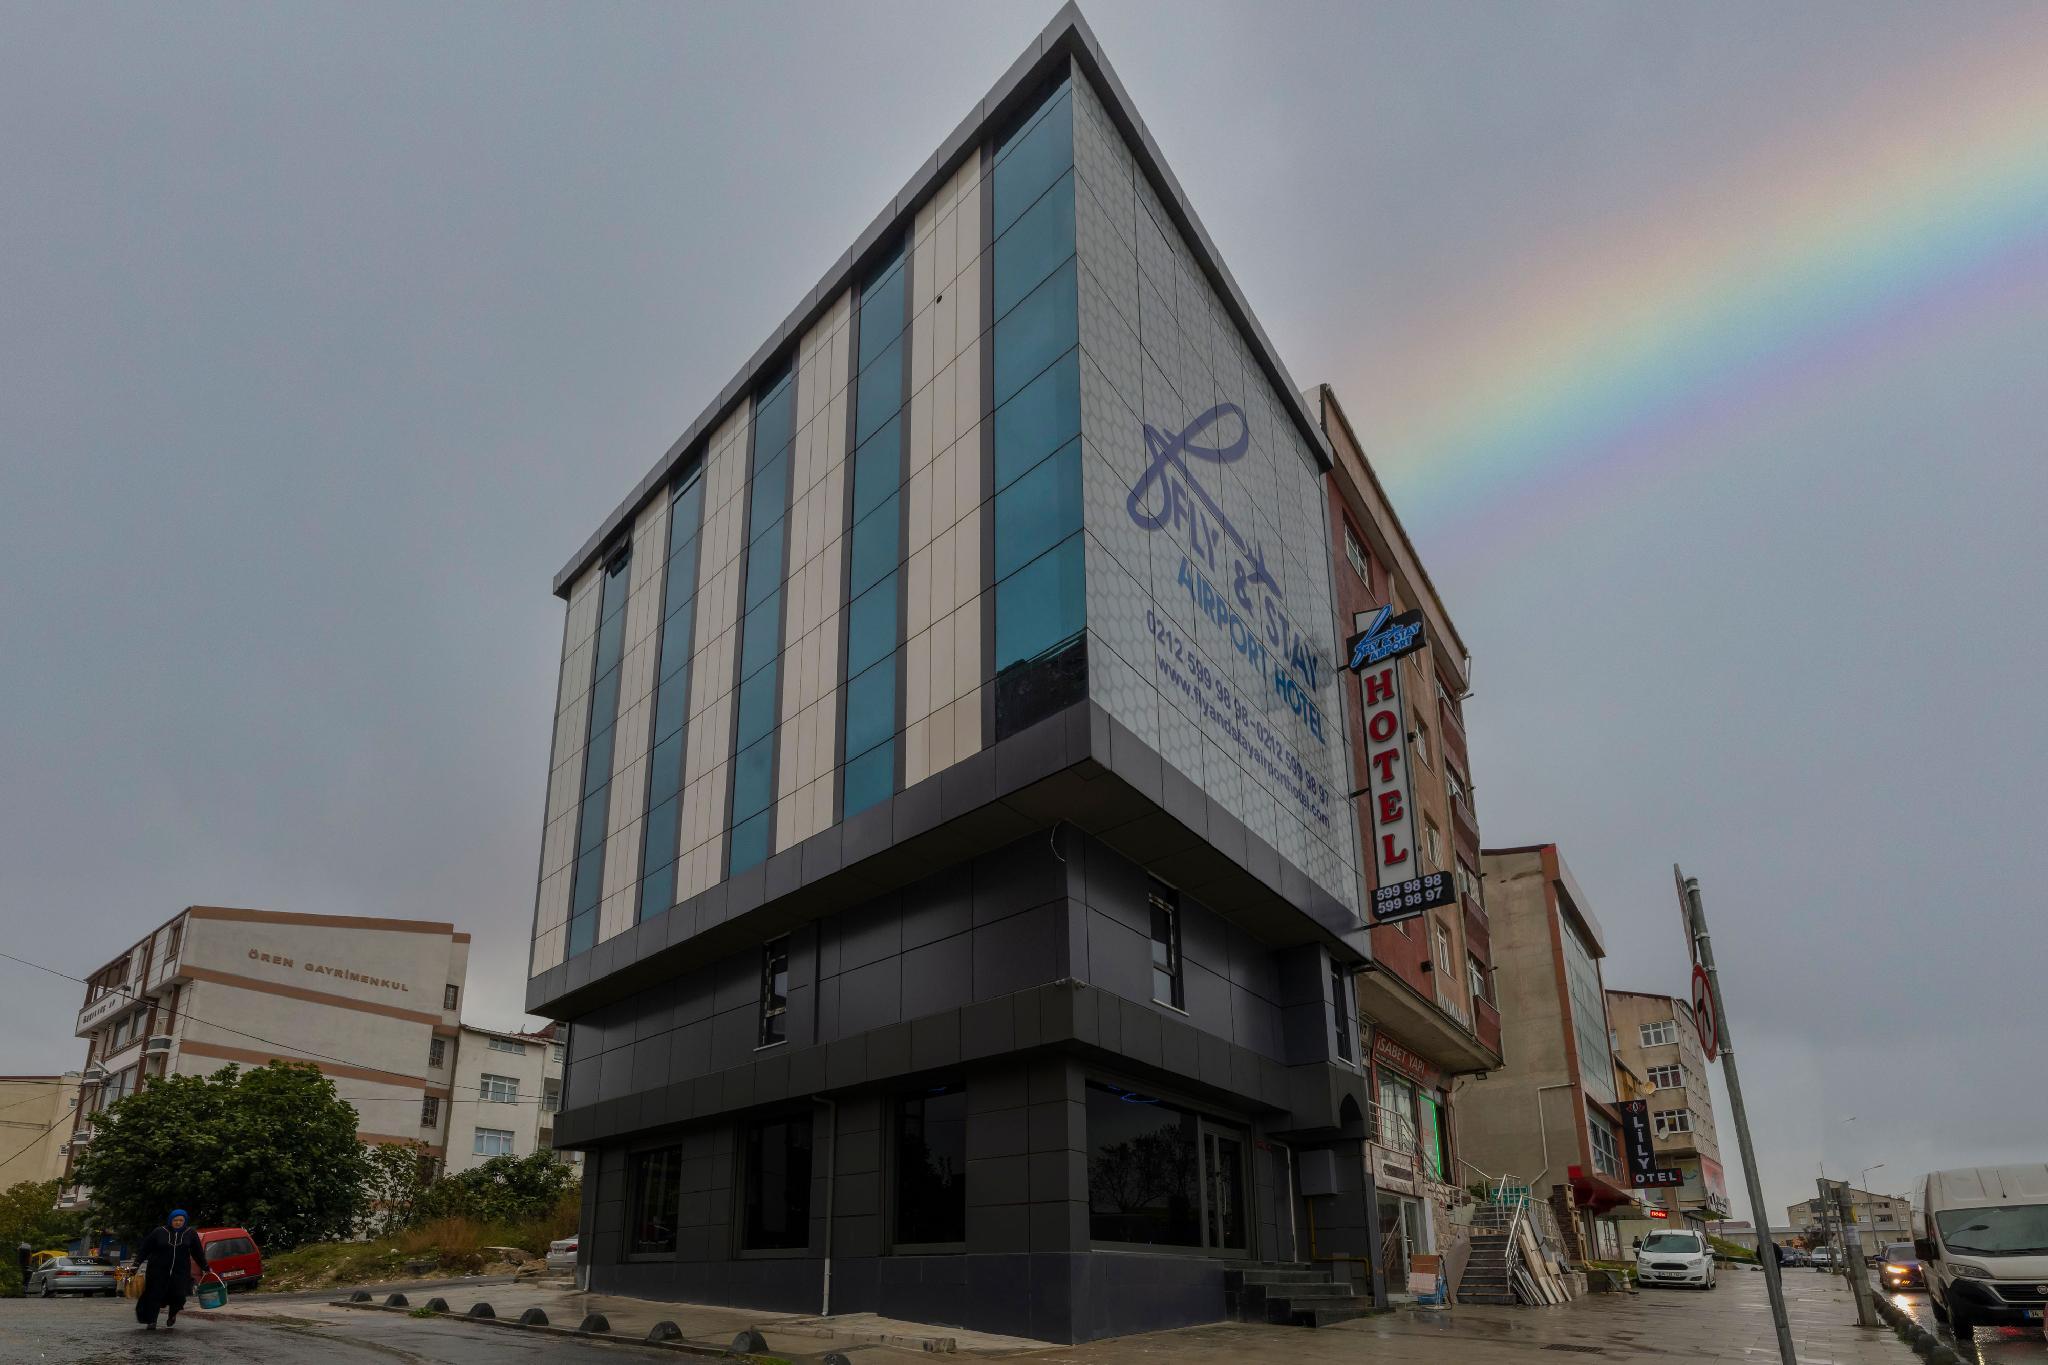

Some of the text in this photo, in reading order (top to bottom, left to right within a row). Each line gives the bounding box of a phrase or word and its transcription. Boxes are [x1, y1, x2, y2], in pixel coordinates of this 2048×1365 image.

[1171, 475, 1318, 693] FLY & STAY
[1370, 636, 1414, 662] AIRPORT
[1394, 621, 1421, 641] STAY
[1177, 555, 1326, 745] AIRPORT HOTEL
[1146, 609, 1183, 663] 0212
[1187, 650, 1212, 690] 599
[1215, 679, 1231, 710] 98
[1285, 750, 1303, 783] 599
[1305, 769, 1317, 796] 98
[1318, 783, 1329, 808] 97
[1364, 668, 1408, 866] HOTEL
[1376, 873, 1442, 901] 599 98 98
[1377, 886, 1443, 914] 599 98 97
[248, 948, 409, 992] ÖREN GAYRİMENKUL
[1635, 1171, 1678, 1183] OTEL
